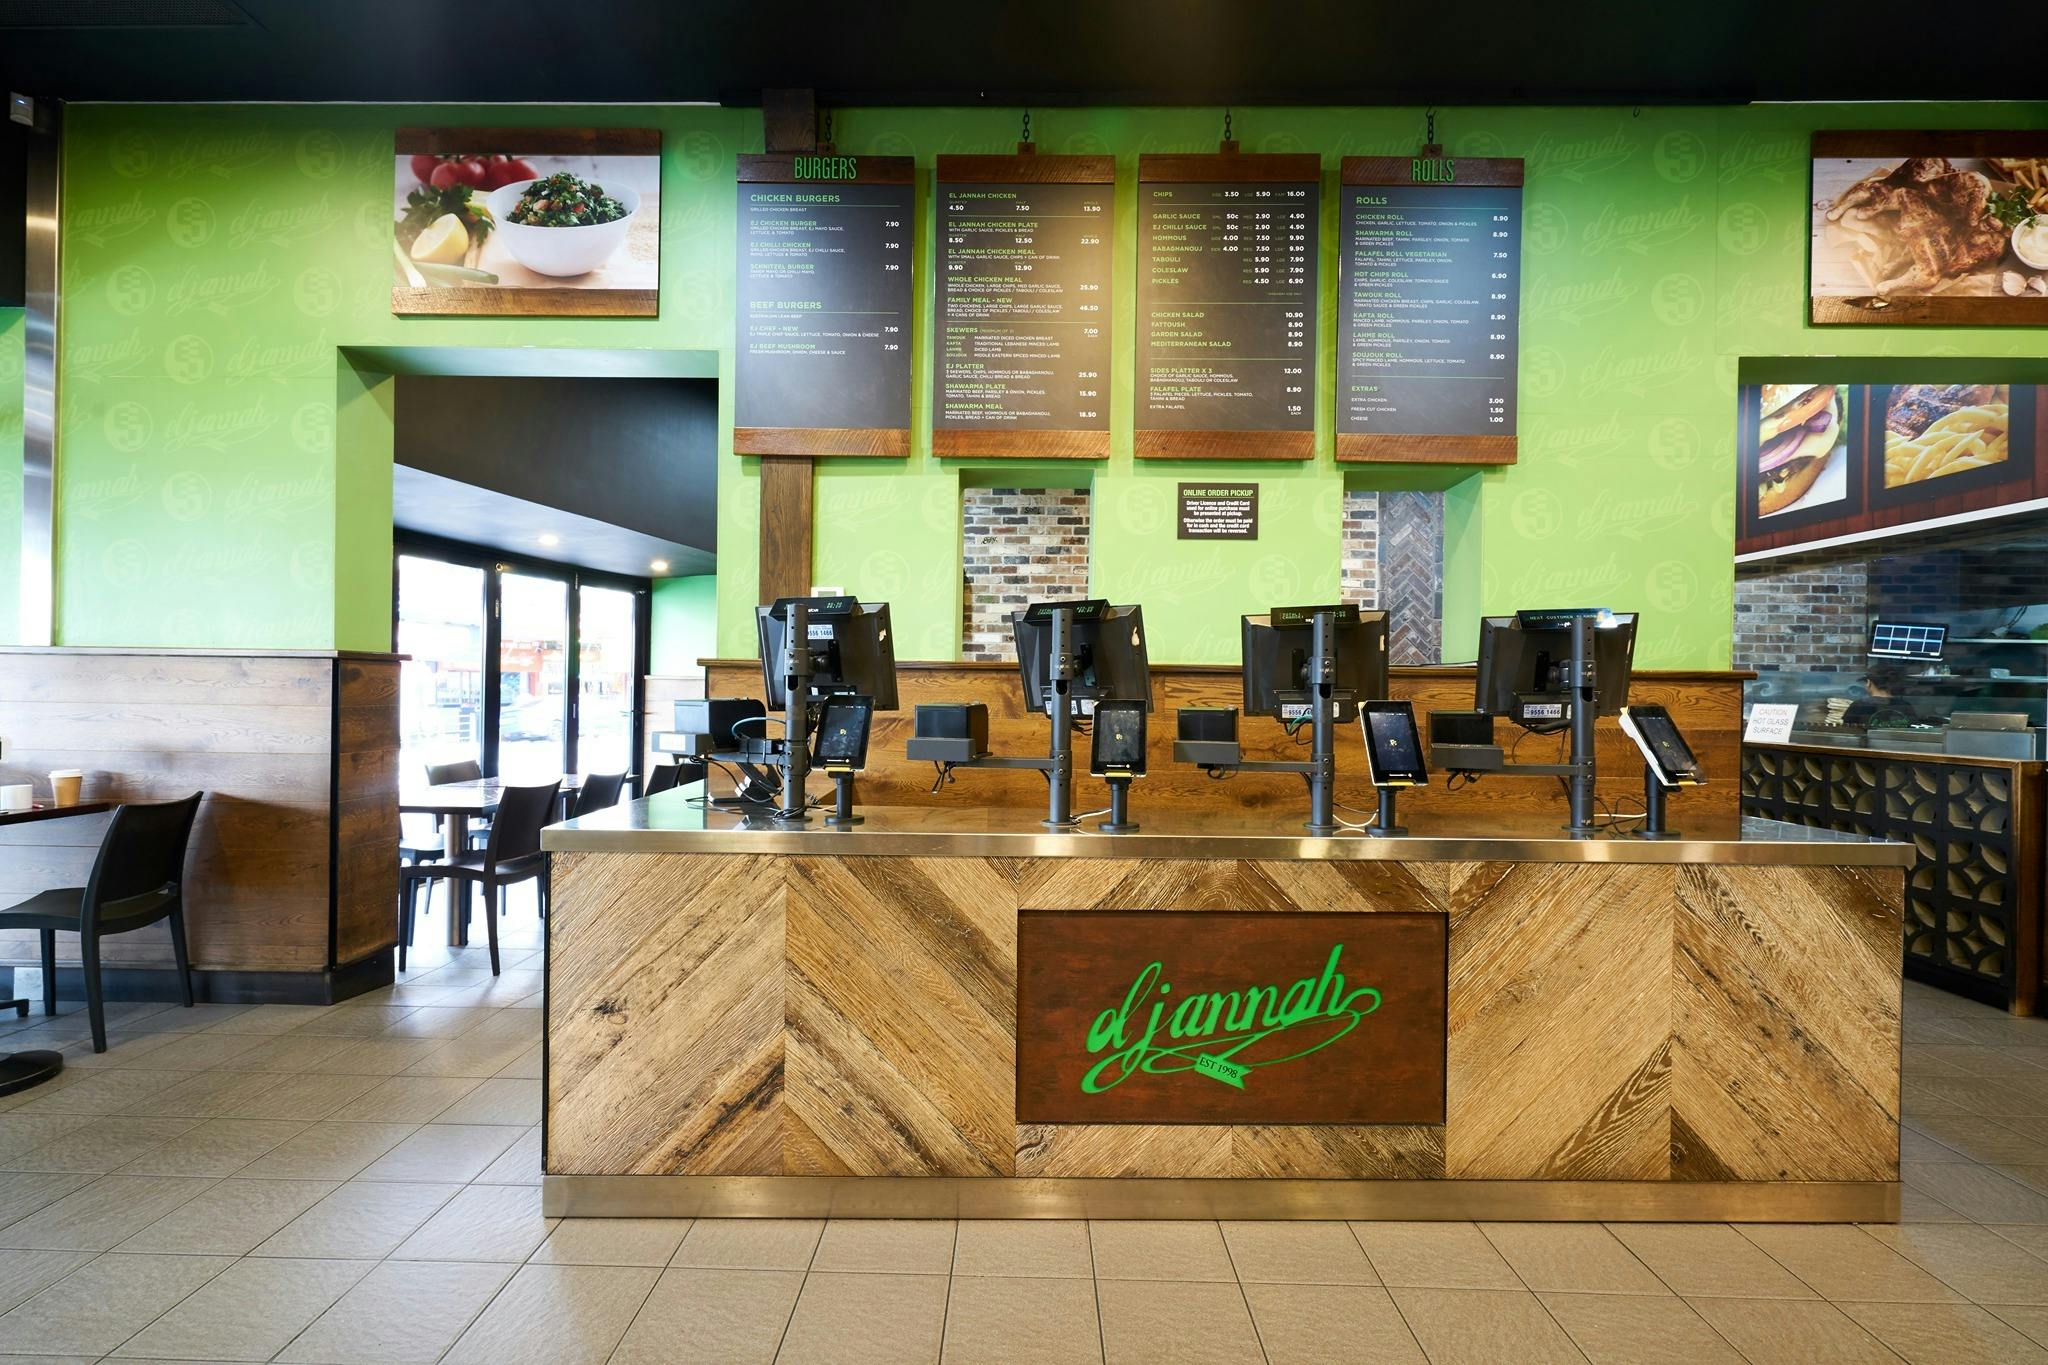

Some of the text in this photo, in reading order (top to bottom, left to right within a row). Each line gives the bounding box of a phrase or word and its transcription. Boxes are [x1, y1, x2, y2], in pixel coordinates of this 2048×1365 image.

[794, 157, 856, 179] BURGERS
[1412, 159, 1455, 182] ROLLS
[796, 195, 840, 203] BURGERS
[1356, 197, 1388, 205] ROLLS
[1759, 708, 1788, 716] CAUTION
[1767, 718, 1789, 726] GLASS
[1753, 726, 1783, 735] SURFACE
[1200, 1056, 1238, 1079] EST 1998
